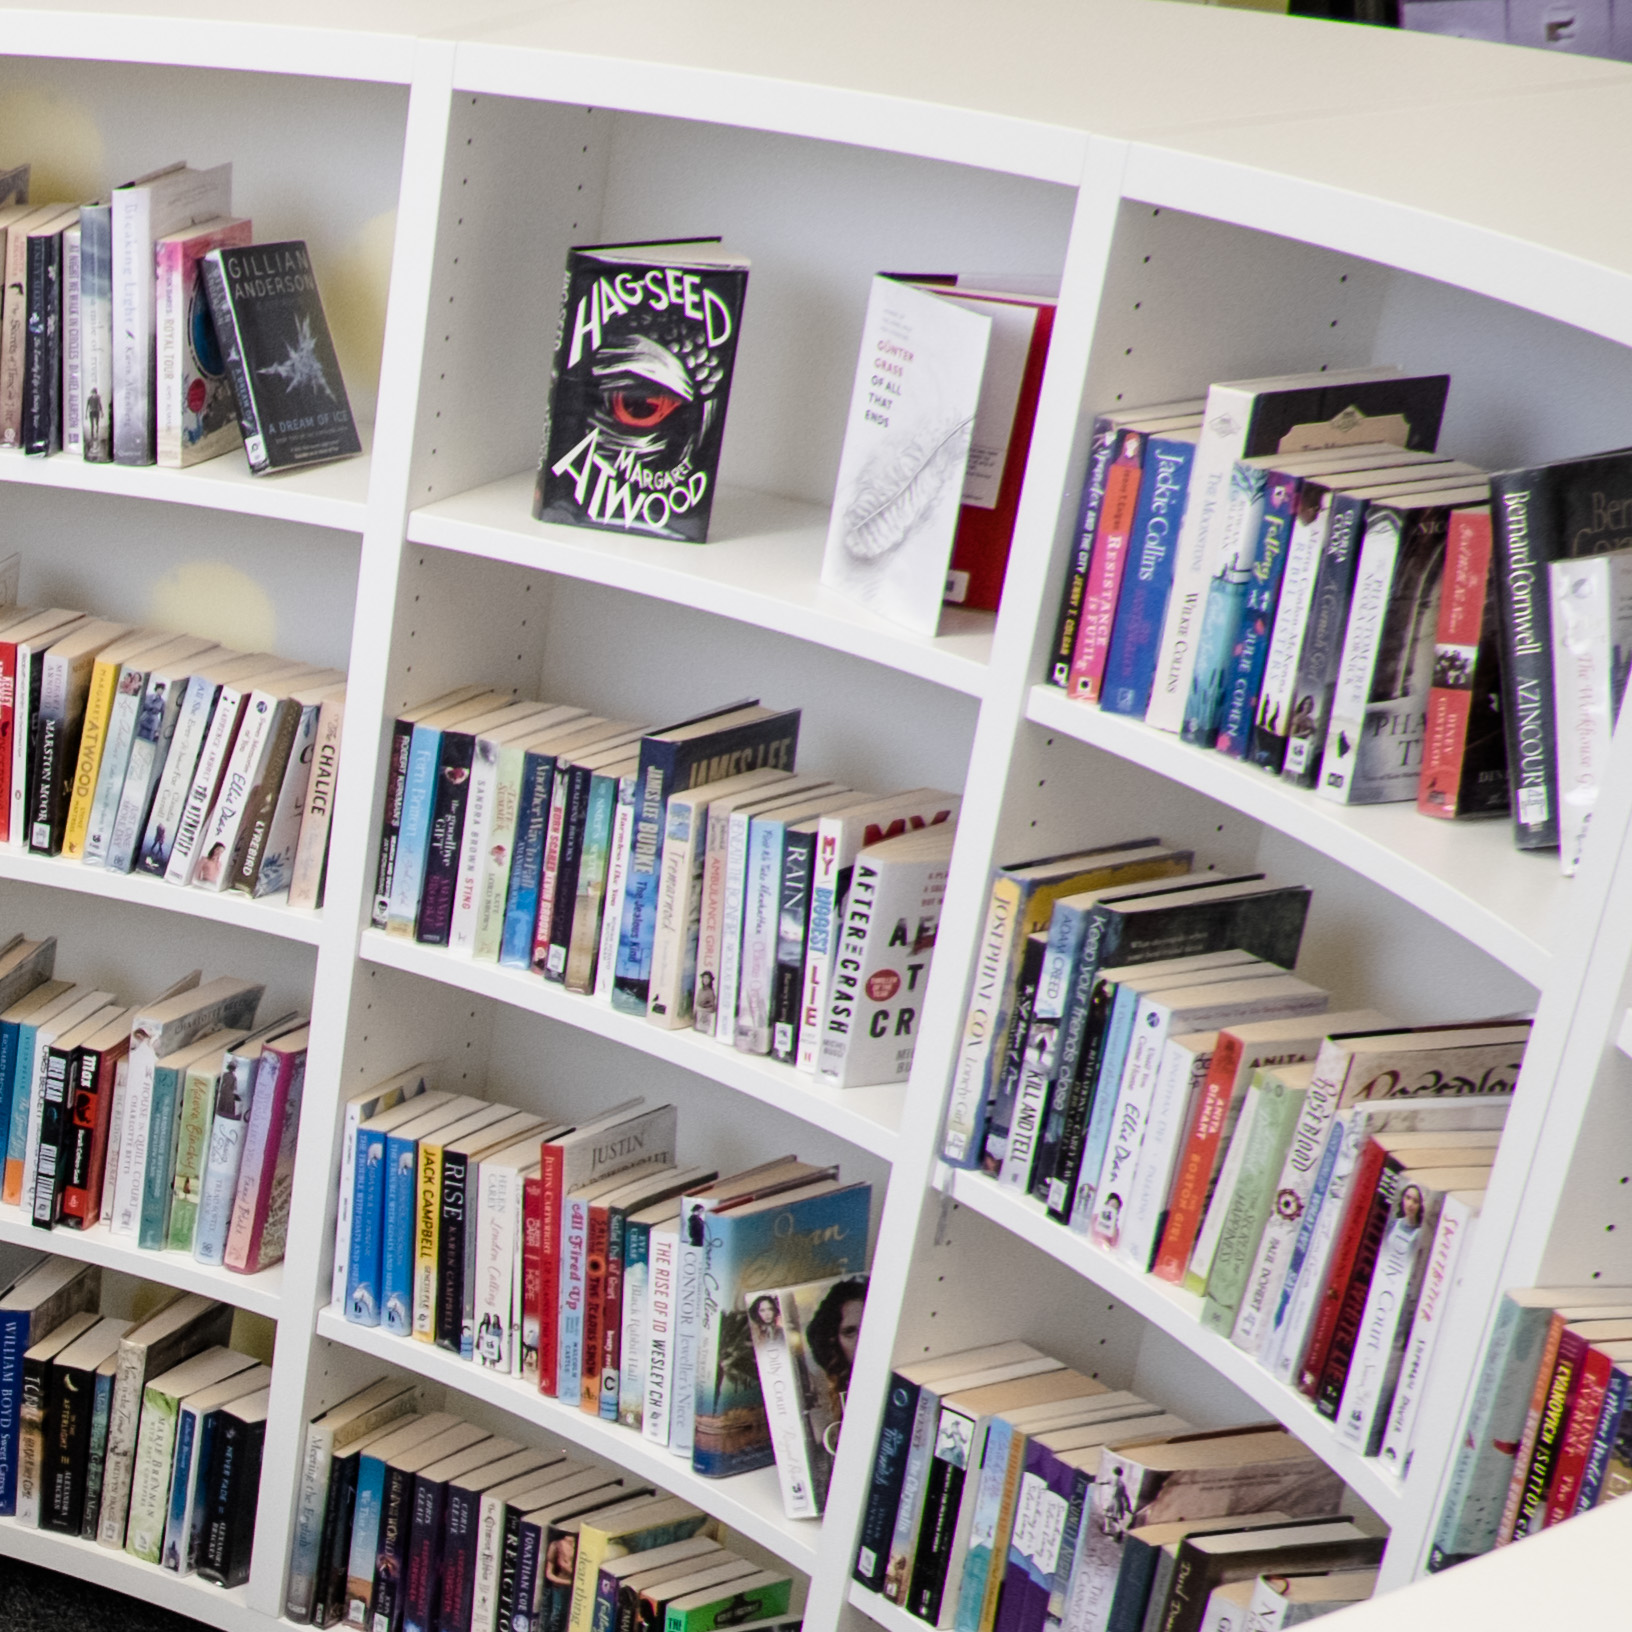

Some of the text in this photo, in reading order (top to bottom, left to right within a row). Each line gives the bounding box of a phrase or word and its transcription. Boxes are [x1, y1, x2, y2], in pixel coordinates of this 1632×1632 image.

[227, 250, 309, 279] GILLIAN
[235, 275, 314, 299] ANDERSON
[567, 268, 733, 370] HAG-SEED
[875, 338, 916, 364] GÜNTER
[867, 392, 894, 412] THAT
[873, 357, 905, 379] GRASS
[268, 410, 348, 434] A DREAM OF ICE
[864, 409, 891, 428] ENDS
[551, 427, 709, 530] ATWOOD
[613, 445, 694, 492] MARGARET
[1139, 448, 1184, 583] Jackie Collins
[1096, 535, 1123, 648] RESISTANCE
[1505, 490, 1542, 659] Bernard Cornwell
[1166, 592, 1199, 695] WILKIE COLLINS
[1229, 630, 1257, 737] JULIE COHEN
[37, 719, 55, 823] MARSTON MOOR
[76, 718, 99, 798] ATWOOD
[311, 744, 336, 816] CHALICE
[241, 820, 267, 877] LYREBIRD
[461, 780, 486, 911] SANDRA BROWN STING
[784, 847, 808, 910] RAIN
[704, 855, 722, 968] AMBULANCE GIRLS
[805, 835, 837, 1027] MY BIGGEST LIE
[828, 865, 878, 1035] AFTER CRASH
[968, 896, 1012, 1048] JOSEPHINE COX
[1047, 913, 1074, 1001] ADAM CREED
[180, 1077, 208, 1172] Maeve Binchy
[591, 1135, 644, 1172] JUSTIN
[1010, 1069, 1045, 1164] KILL AND TELL
[1207, 1097, 1225, 1135] ANITA
[420, 1148, 436, 1259] JACK CAMPBELL
[443, 1162, 465, 1222] RISE
[568, 1203, 584, 1310] All Fired Up
[678, 1251, 695, 1326] CONNOR
[1366, 1230, 1414, 1352] Dilly Court
[2, 1322, 17, 1384] WILLIAM
[767, 1344, 787, 1417] Dilly Court
[0, 1389, 13, 1428] BOYD
[0, 1433, 11, 1459] Sweet
[899, 1472, 920, 1535] Chrysalis
[668, 1617, 682, 1629] THE
